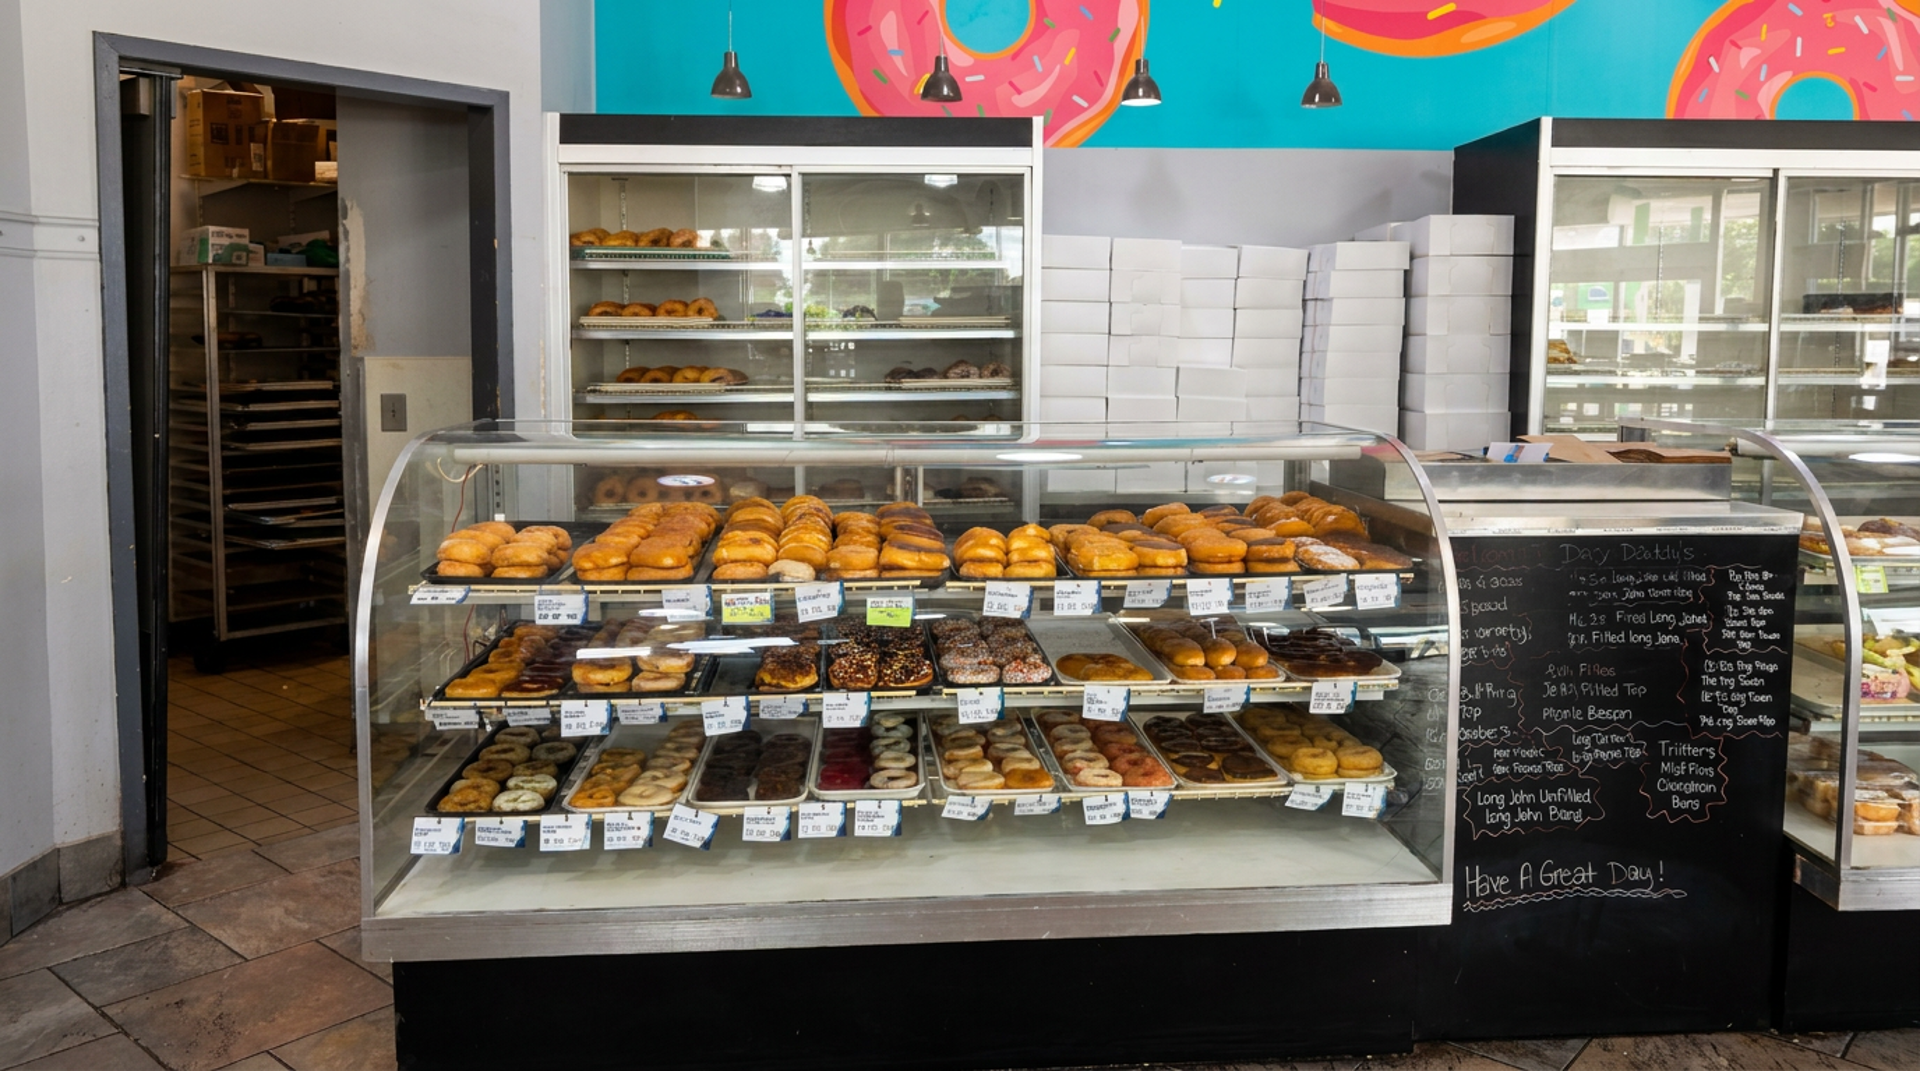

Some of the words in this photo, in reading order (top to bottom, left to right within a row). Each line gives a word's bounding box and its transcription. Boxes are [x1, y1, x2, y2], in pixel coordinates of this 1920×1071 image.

[1477, 790, 1505, 810] Long
[1509, 788, 1536, 806] John
[1514, 806, 1543, 822] John
[1465, 864, 1512, 898] Have
[1520, 861, 1533, 890] A
[1539, 859, 1598, 887] Great
